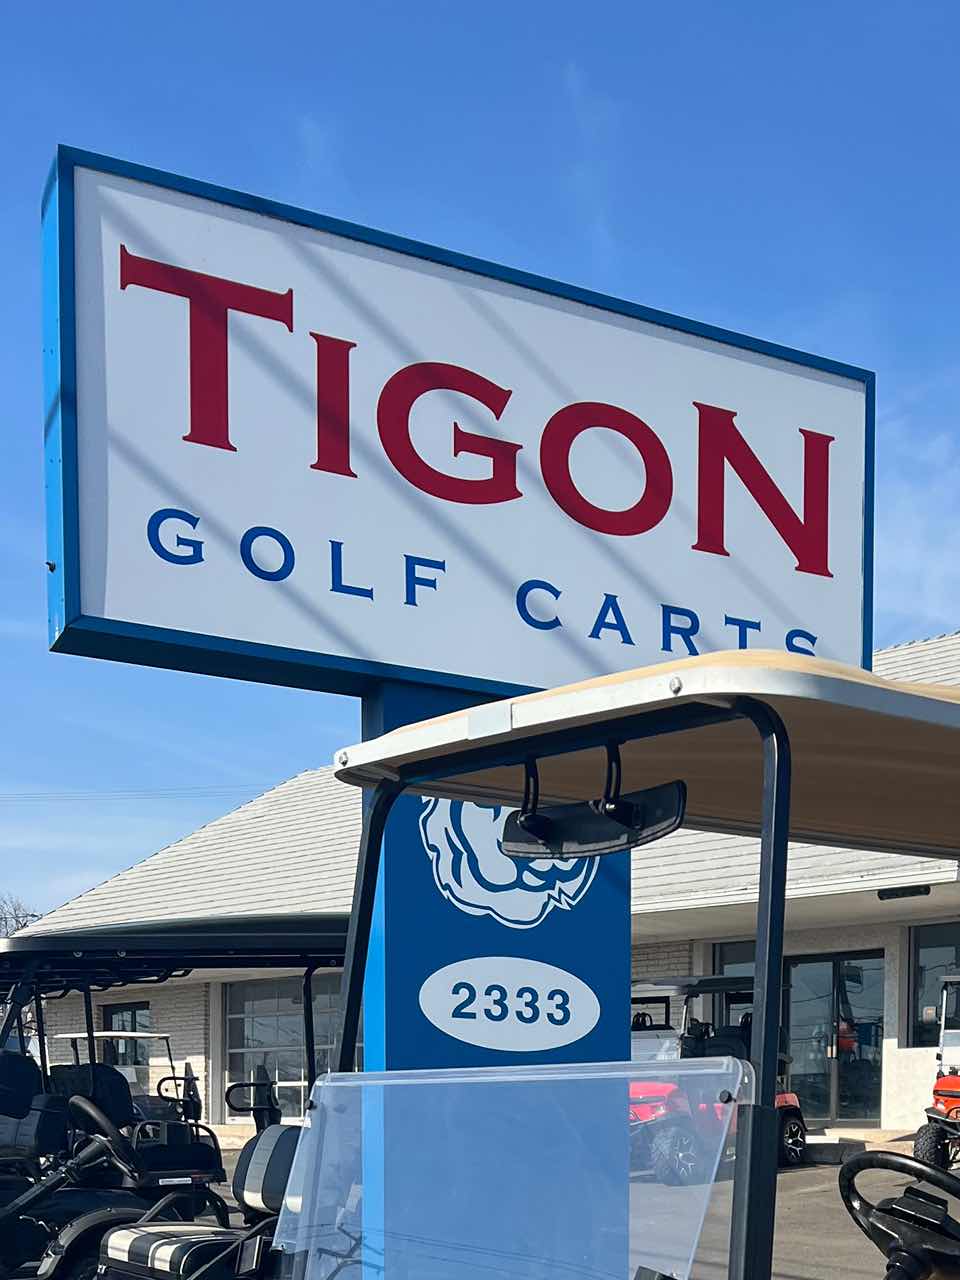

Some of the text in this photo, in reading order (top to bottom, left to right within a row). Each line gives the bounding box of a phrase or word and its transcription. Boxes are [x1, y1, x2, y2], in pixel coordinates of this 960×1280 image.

[119, 244, 835, 578] TIGON
[147, 508, 818, 656] GOLF CARTS
[452, 982, 571, 1026] 2333
